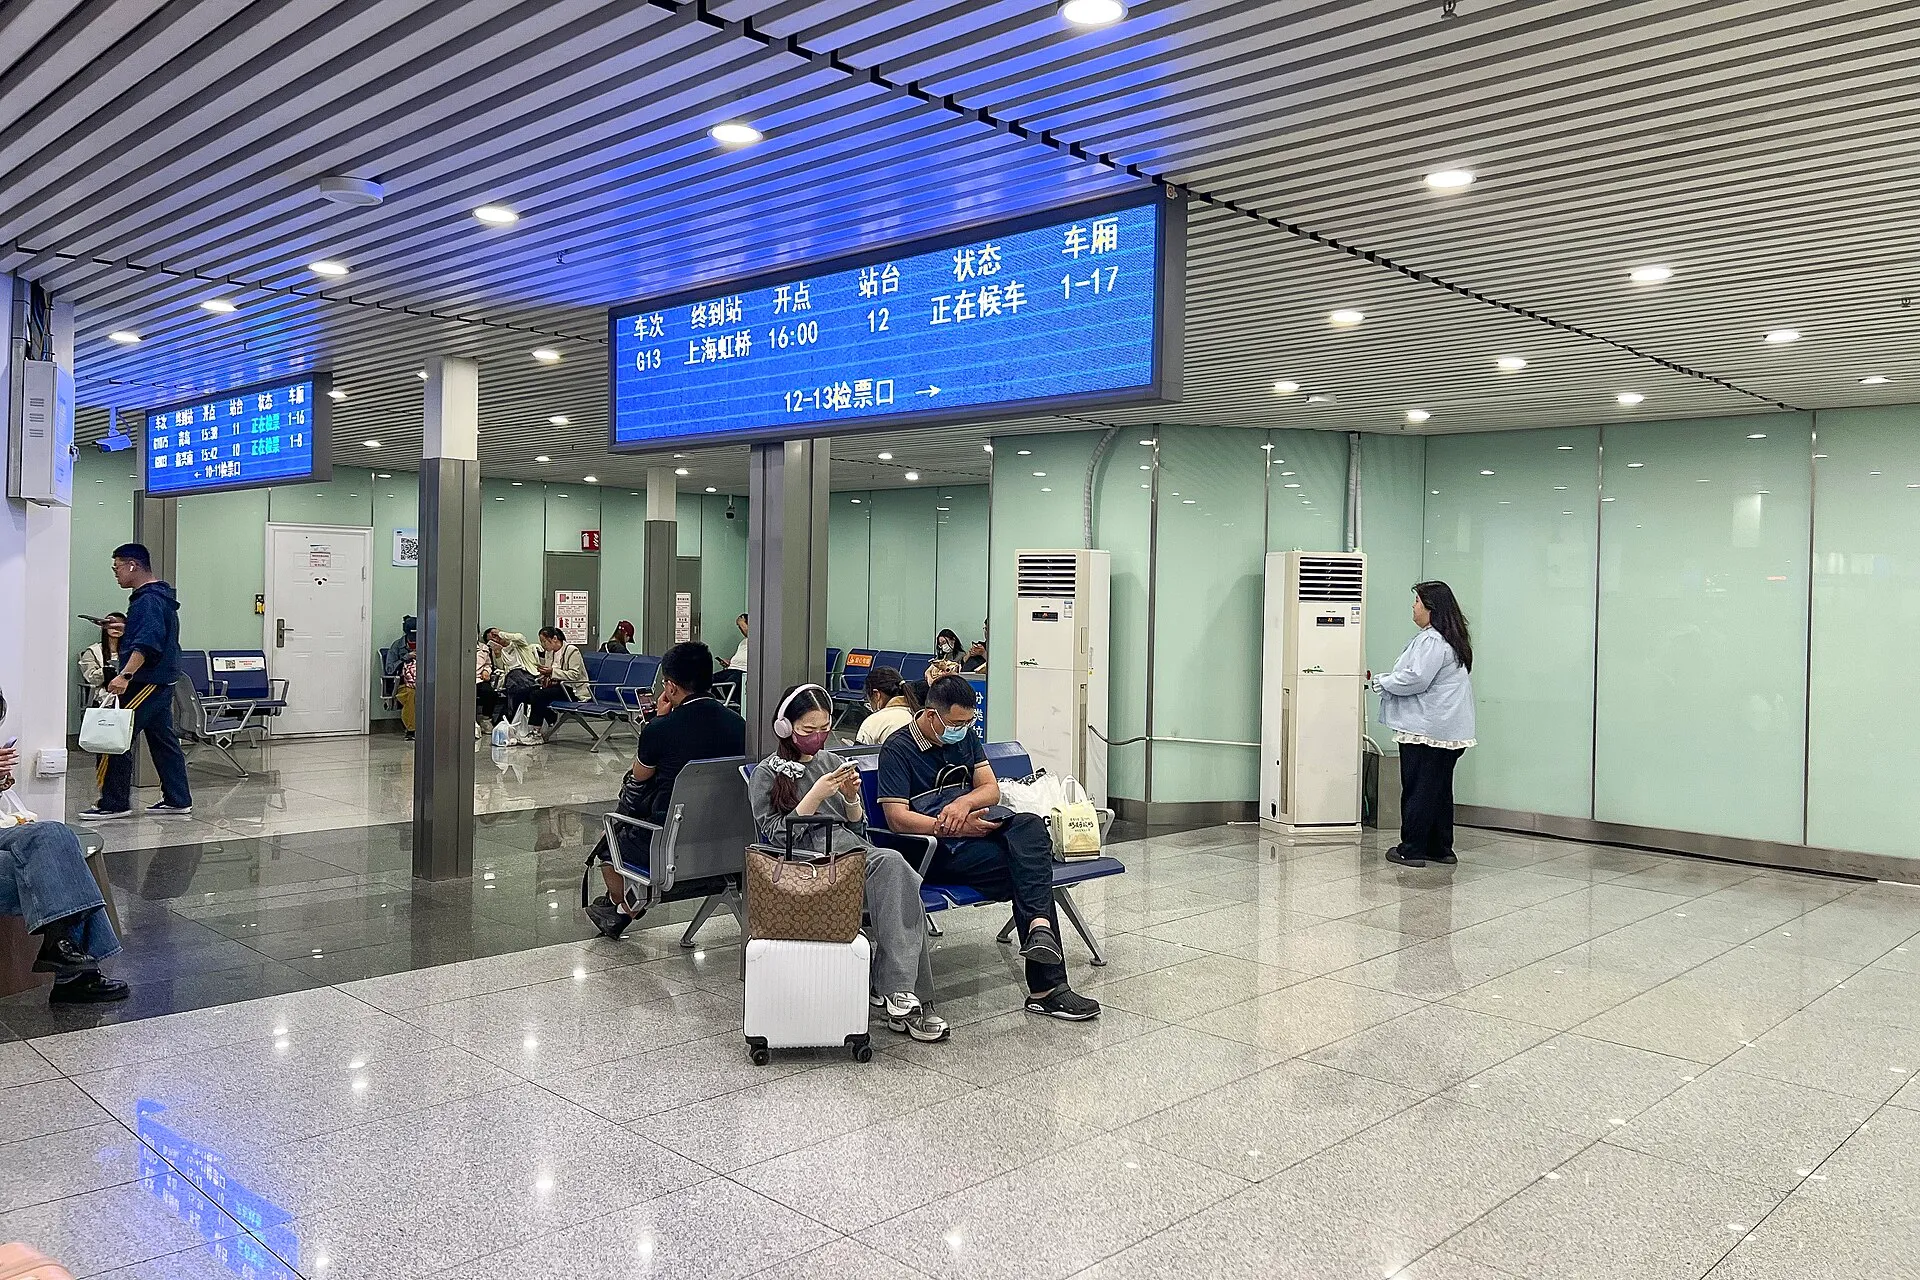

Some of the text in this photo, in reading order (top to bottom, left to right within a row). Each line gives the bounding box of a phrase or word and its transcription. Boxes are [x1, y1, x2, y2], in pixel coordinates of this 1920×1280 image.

[634, 217, 1119, 342] 车次 终到站 开点 站台 状态 车厢
[636, 266, 1119, 371] G13 上海虹桥 16:00 12 正在候车 1-17
[232, 423, 240, 435] 11
[288, 410, 305, 426] 1-16
[232, 443, 241, 457] 10
